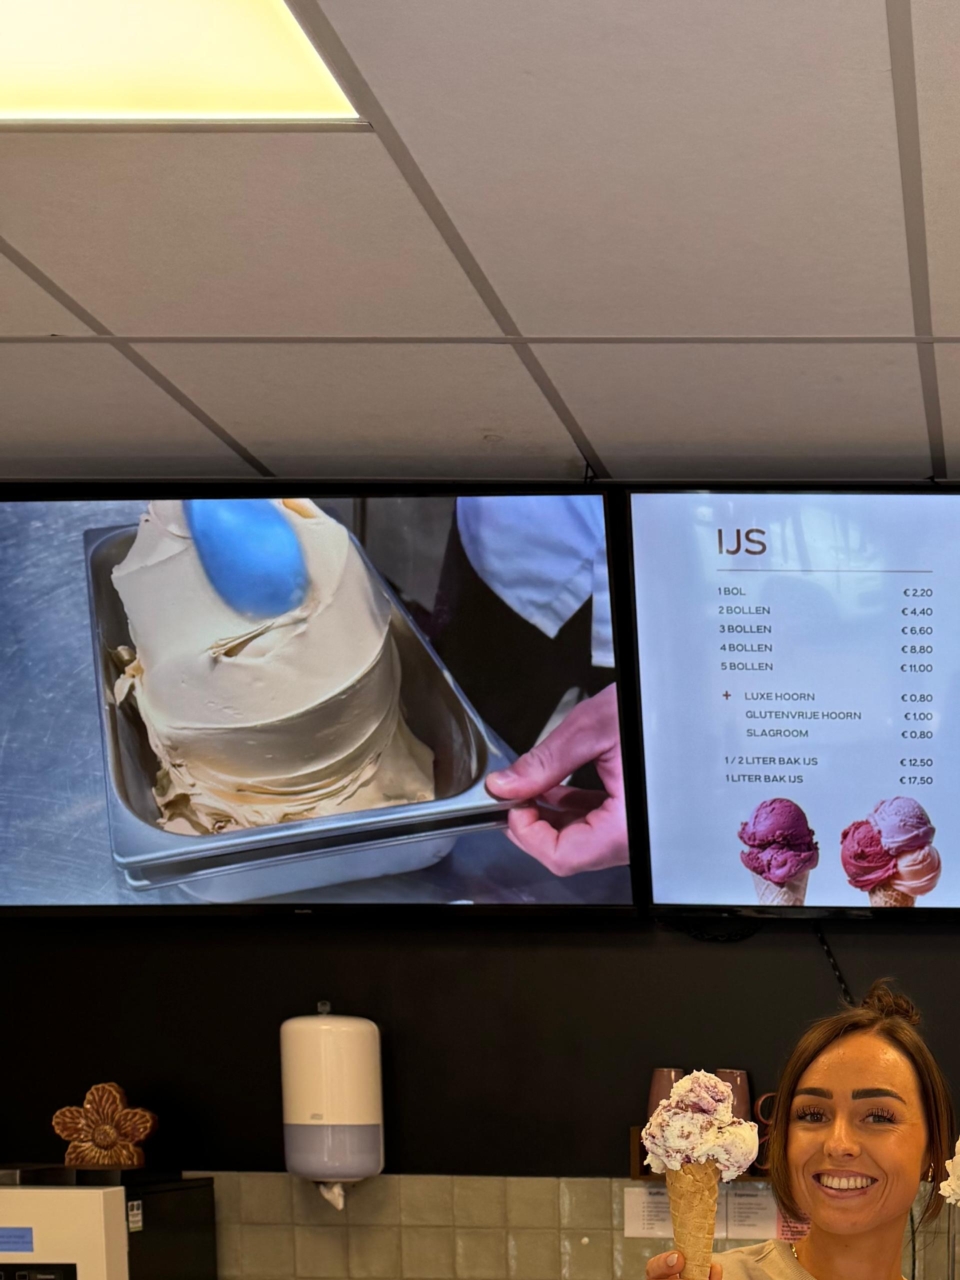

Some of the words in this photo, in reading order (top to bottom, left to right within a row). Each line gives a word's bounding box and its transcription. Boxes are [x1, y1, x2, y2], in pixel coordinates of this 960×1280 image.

[718, 529, 766, 555] IJS
[724, 587, 746, 596] BOL
[903, 588, 910, 597] €
[719, 606, 724, 614] 2
[726, 606, 770, 615] BOLLEN
[901, 608, 908, 616] €
[719, 625, 725, 633] 3
[727, 625, 771, 633] BOLLEN
[901, 626, 908, 635] €
[729, 643, 772, 652] BOLLEN
[901, 645, 908, 653] €
[721, 662, 727, 670] 5
[729, 662, 773, 671] BOLLEN
[900, 664, 907, 672] €
[745, 692, 773, 701] LUXE
[775, 692, 815, 701] HOORN
[901, 694, 907, 702] €
[746, 710, 819, 719] GLUTENVRIJE
[822, 712, 861, 720] HOORN
[904, 712, 911, 721] €
[747, 729, 808, 738] SLAGROOM
[901, 730, 908, 739] €
[738, 756, 743, 764] 2
[746, 757, 776, 765] LITER
[778, 757, 801, 765] BAK
[803, 757, 818, 765] IJS
[900, 758, 906, 766] €
[731, 774, 762, 782] LITER
[764, 775, 786, 783] BAK
[789, 775, 803, 783] IJS
[899, 776, 906, 784] €
